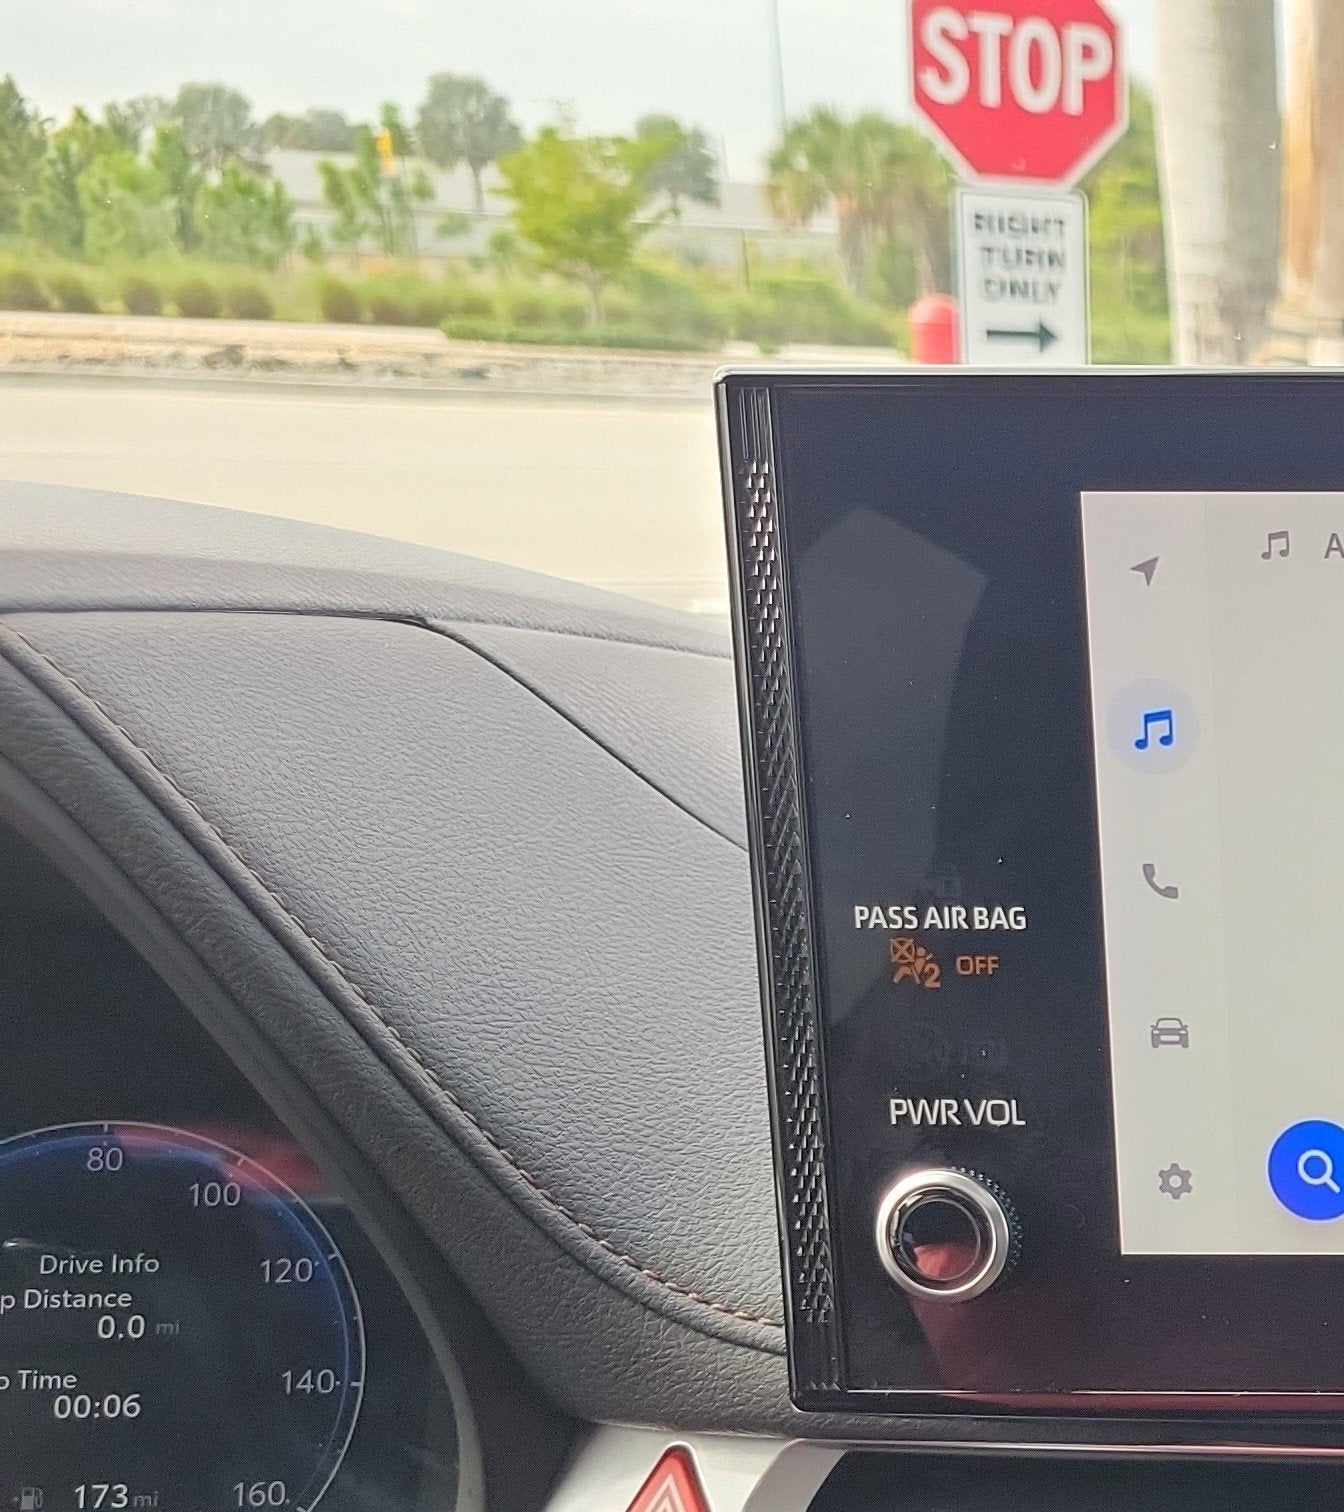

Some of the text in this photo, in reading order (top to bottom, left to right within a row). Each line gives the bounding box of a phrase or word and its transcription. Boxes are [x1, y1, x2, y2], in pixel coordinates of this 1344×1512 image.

[917, 6, 1113, 116] STOP
[974, 213, 1065, 236] RIGHT
[980, 246, 1065, 267] TURN
[984, 279, 1060, 300] ONLY
[854, 906, 1027, 930] PASS AIR BAG
[955, 956, 999, 975] OFF
[890, 1099, 1026, 1126] PWR VOL
[87, 1147, 123, 1171] 80
[189, 1182, 241, 1207] 100
[40, 1253, 160, 1274] Drive Info
[260, 1258, 313, 1283] 120
[24, 1288, 133, 1309] Distance
[97, 1315, 180, 1339] 0.0 mi
[18, 1369, 78, 1390] Time
[282, 1369, 335, 1394] 140
[54, 1394, 141, 1418] 00:06
[74, 1484, 159, 1509] 173 mi
[234, 1480, 287, 1507] 160
